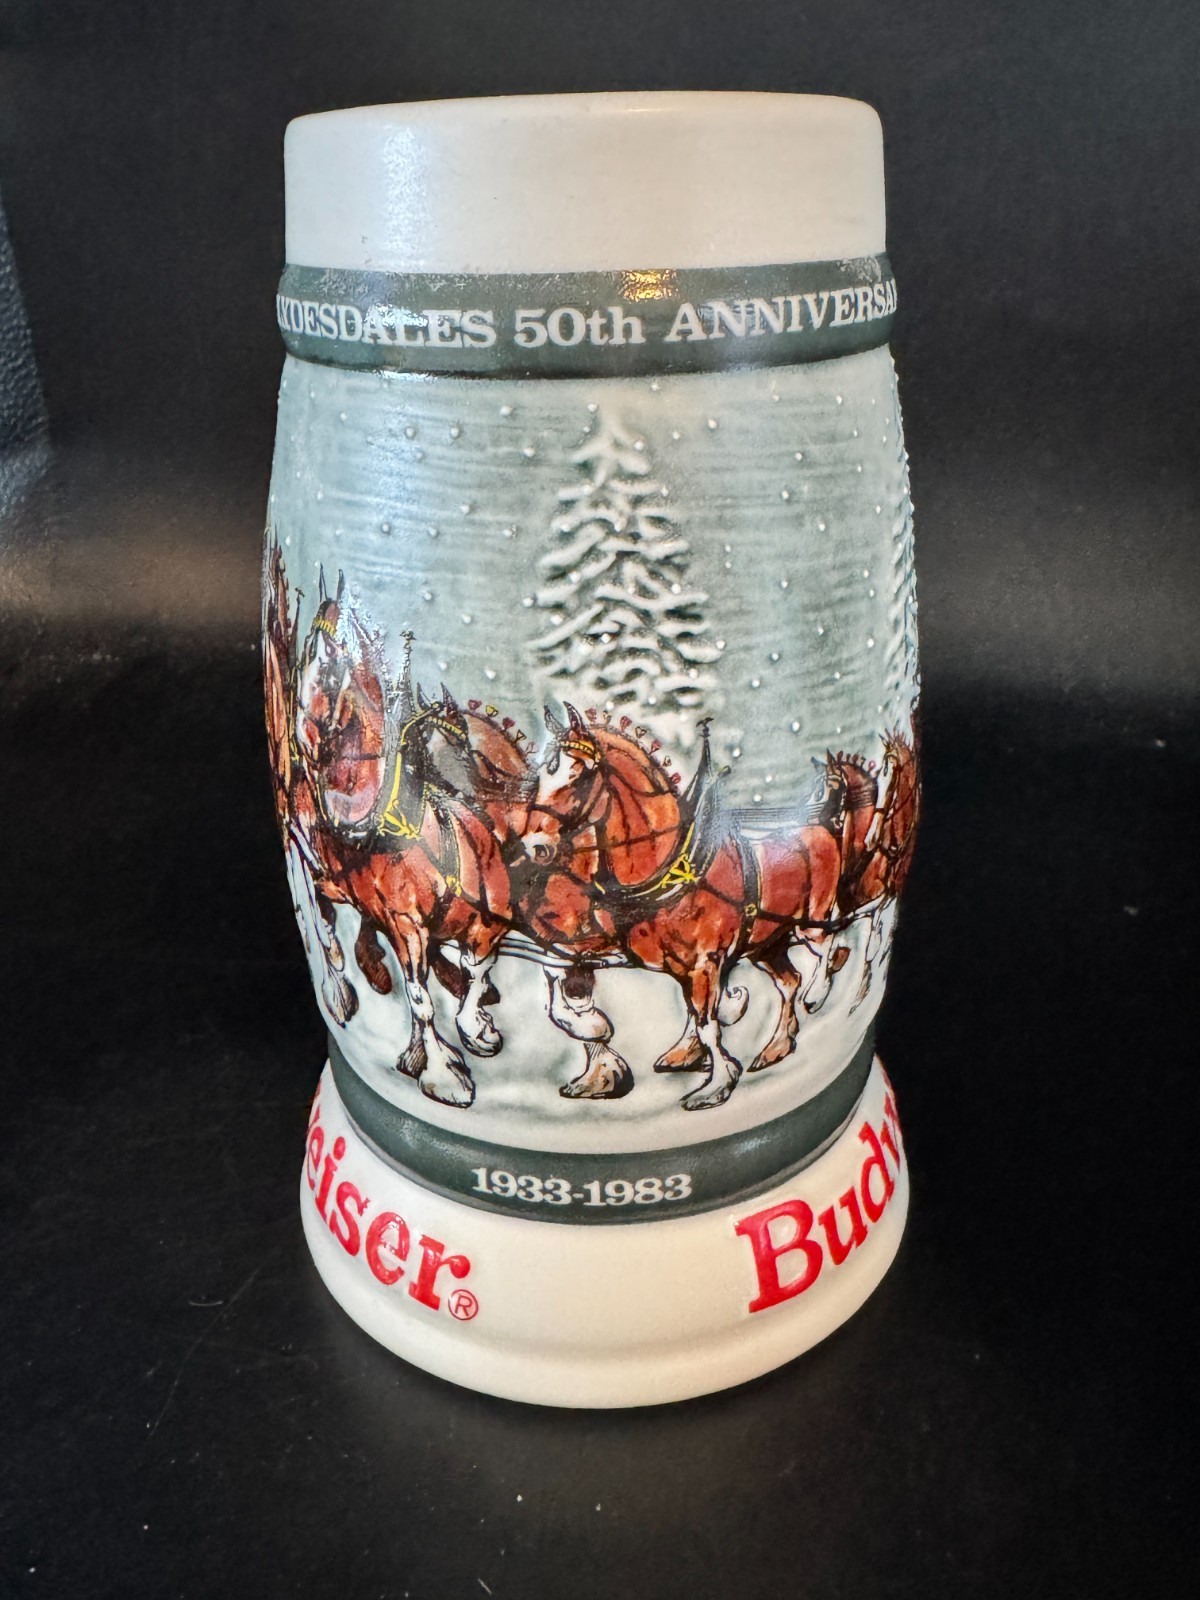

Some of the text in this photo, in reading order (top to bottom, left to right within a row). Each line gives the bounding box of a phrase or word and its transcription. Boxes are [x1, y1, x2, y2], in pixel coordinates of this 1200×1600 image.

[514, 306, 646, 348] 50th
[664, 279, 897, 342] ANNIVERSA
[471, 1167, 692, 1206] 1933-1983
